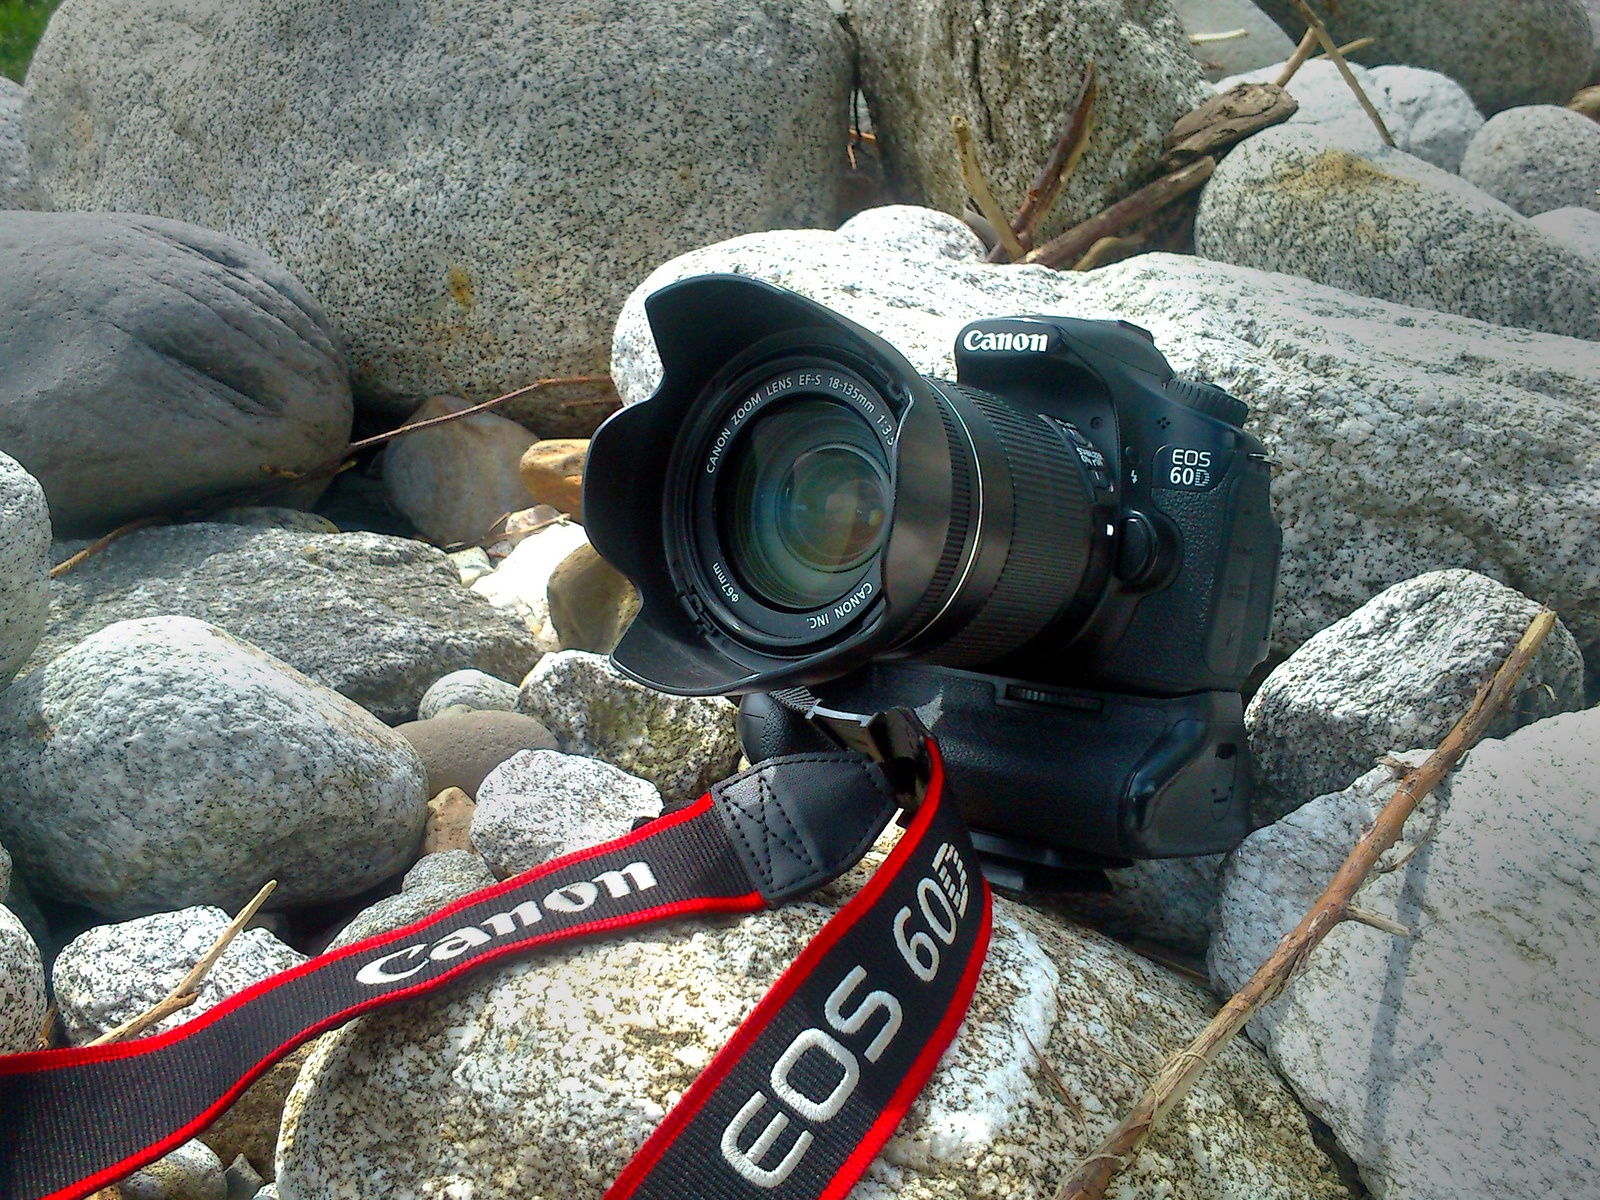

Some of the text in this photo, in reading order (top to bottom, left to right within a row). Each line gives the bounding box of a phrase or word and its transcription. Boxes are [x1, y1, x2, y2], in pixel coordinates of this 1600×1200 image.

[963, 329, 1049, 353] Canon
[706, 427, 731, 474] CANON
[731, 393, 762, 426] ZOOM
[765, 377, 792, 396] LENS
[798, 374, 821, 386] EF-S
[828, 376, 876, 414] 18-135mm
[1169, 466, 1211, 488] 60D
[1171, 448, 1211, 468] EOS
[806, 582, 873, 629] CANON INC.
[354, 861, 658, 985] Canon
[720, 842, 969, 1188] EOS 60D
